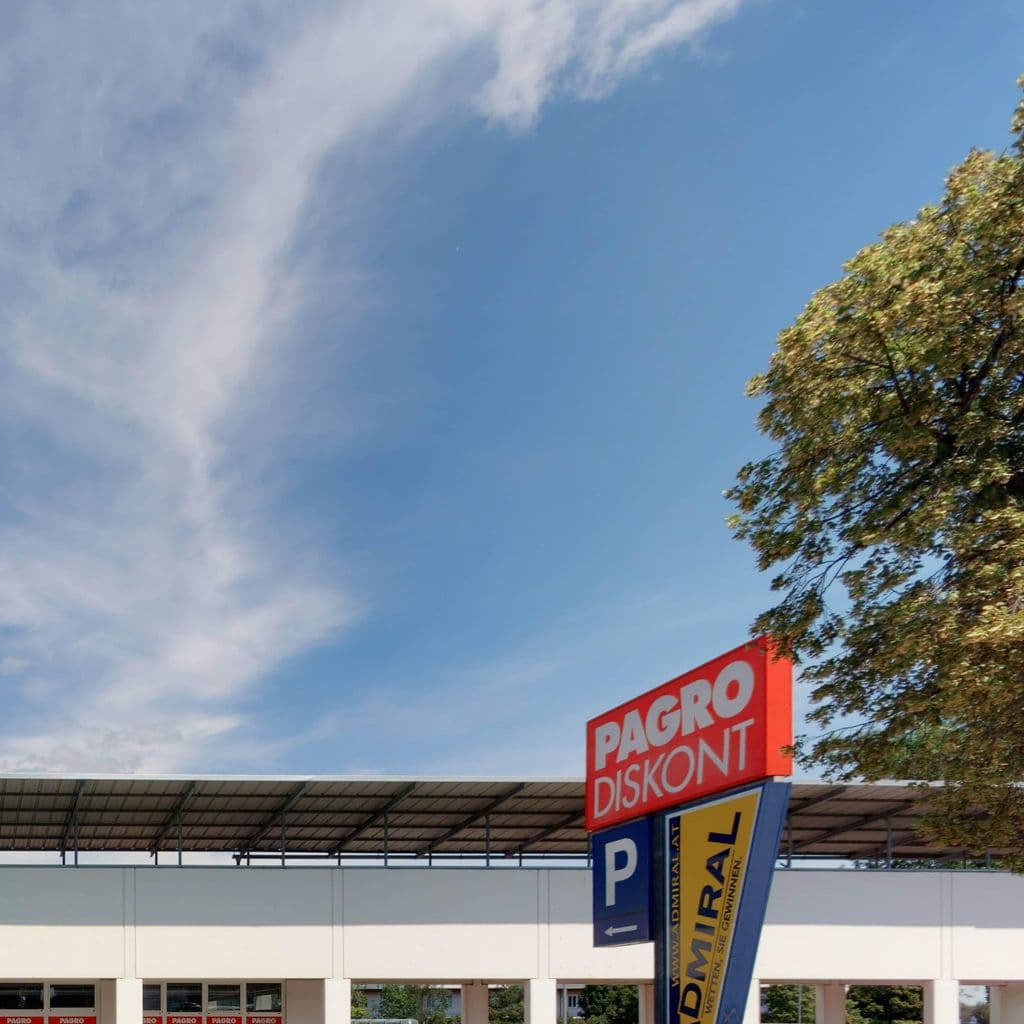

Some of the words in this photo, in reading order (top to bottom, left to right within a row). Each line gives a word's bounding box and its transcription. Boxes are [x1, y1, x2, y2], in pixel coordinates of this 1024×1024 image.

[594, 659, 755, 772] PAGRO
[593, 717, 755, 819] DISKONT
[604, 837, 638, 907] P
[668, 825, 681, 987] WWW.ADMIRAL.AT
[716, 934, 727, 957] SIE
